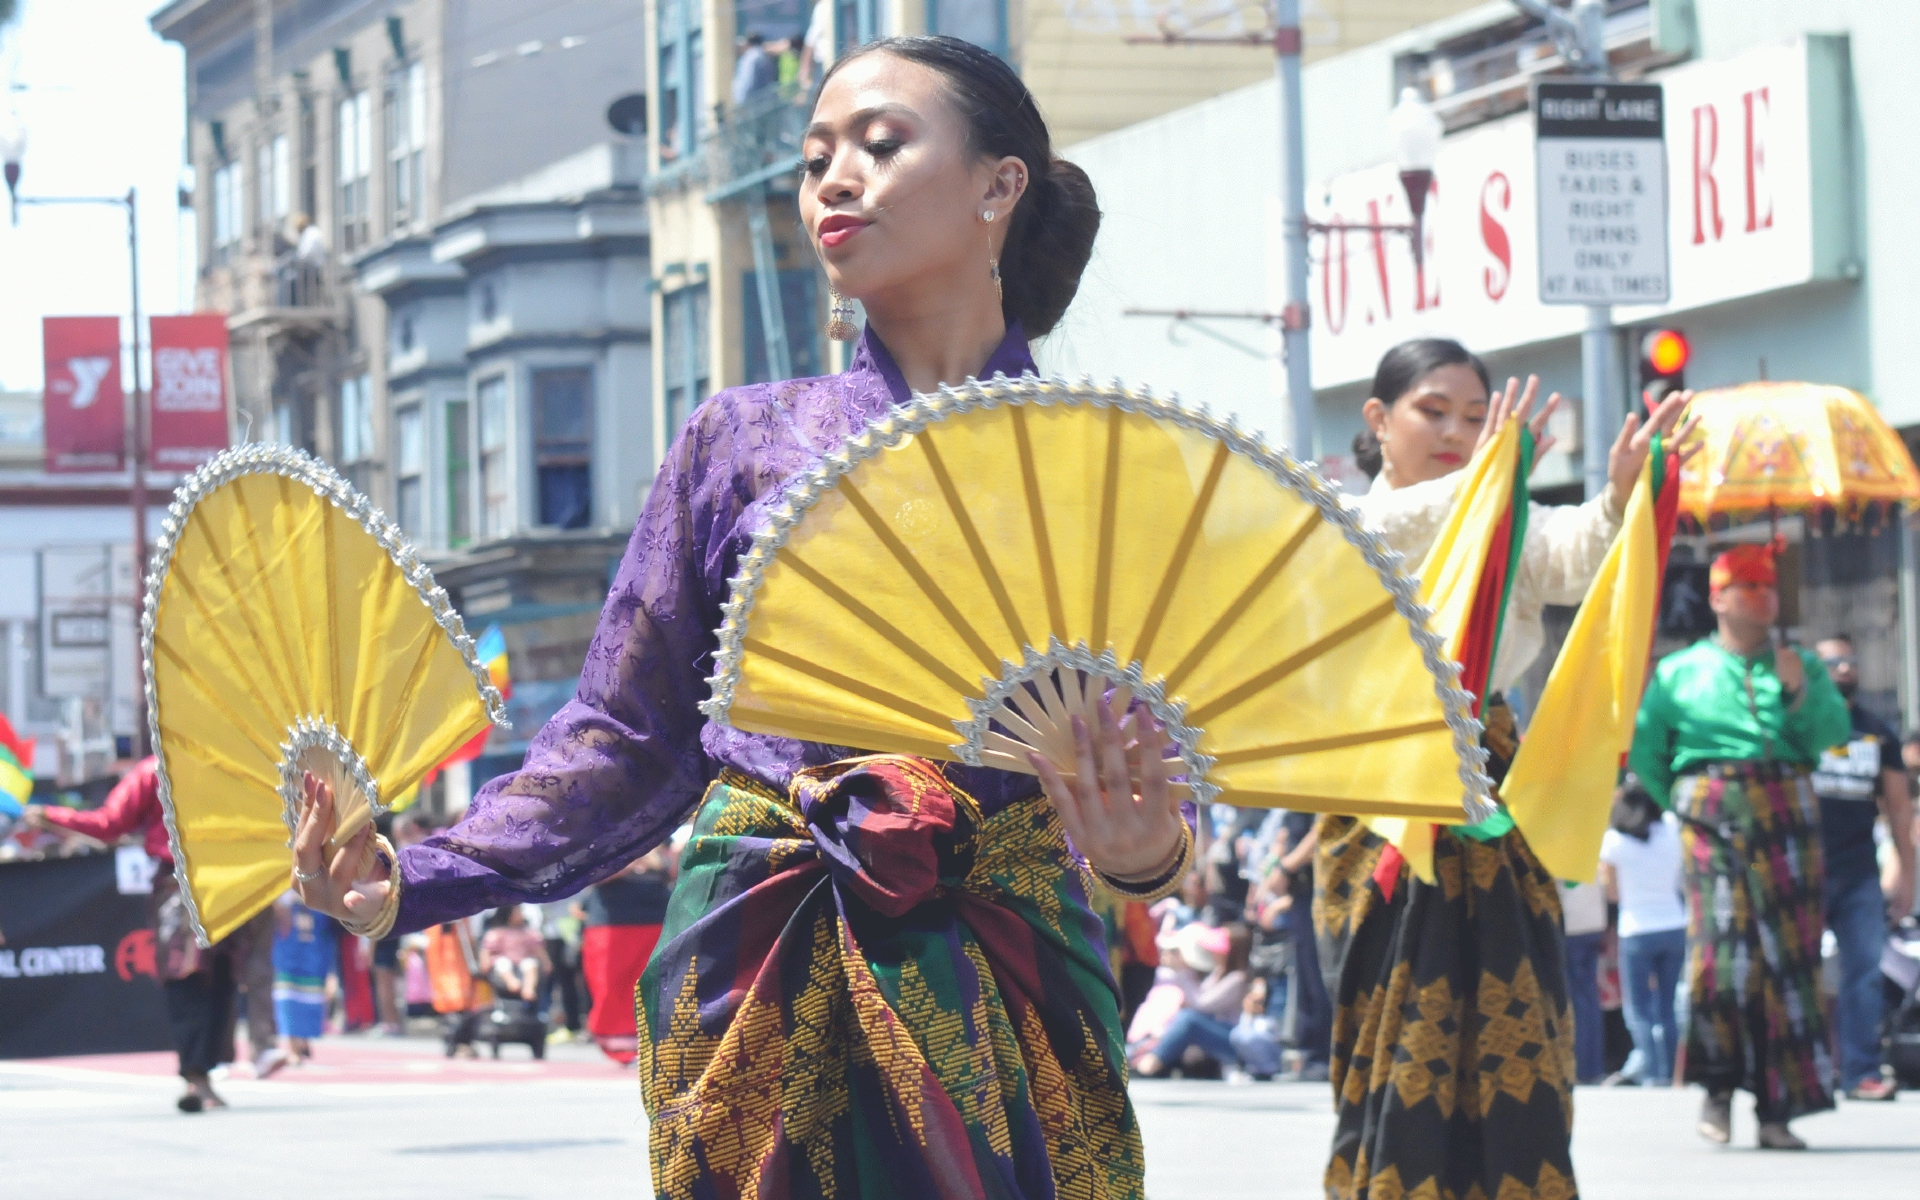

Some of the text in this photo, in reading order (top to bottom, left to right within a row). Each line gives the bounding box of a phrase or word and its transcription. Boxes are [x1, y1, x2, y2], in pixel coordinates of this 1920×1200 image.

[1541, 100, 1659, 122] RIGHT LANE
[1565, 151, 1637, 171] BUSES
[1559, 175, 1620, 195] TAXIS
[1569, 200, 1636, 219] RIGHT
[1567, 224, 1640, 245] TURNS
[1574, 249, 1632, 270] ONLY
[1546, 274, 1664, 296] AT ALL TIMES
[20, 943, 107, 978] CENTER
